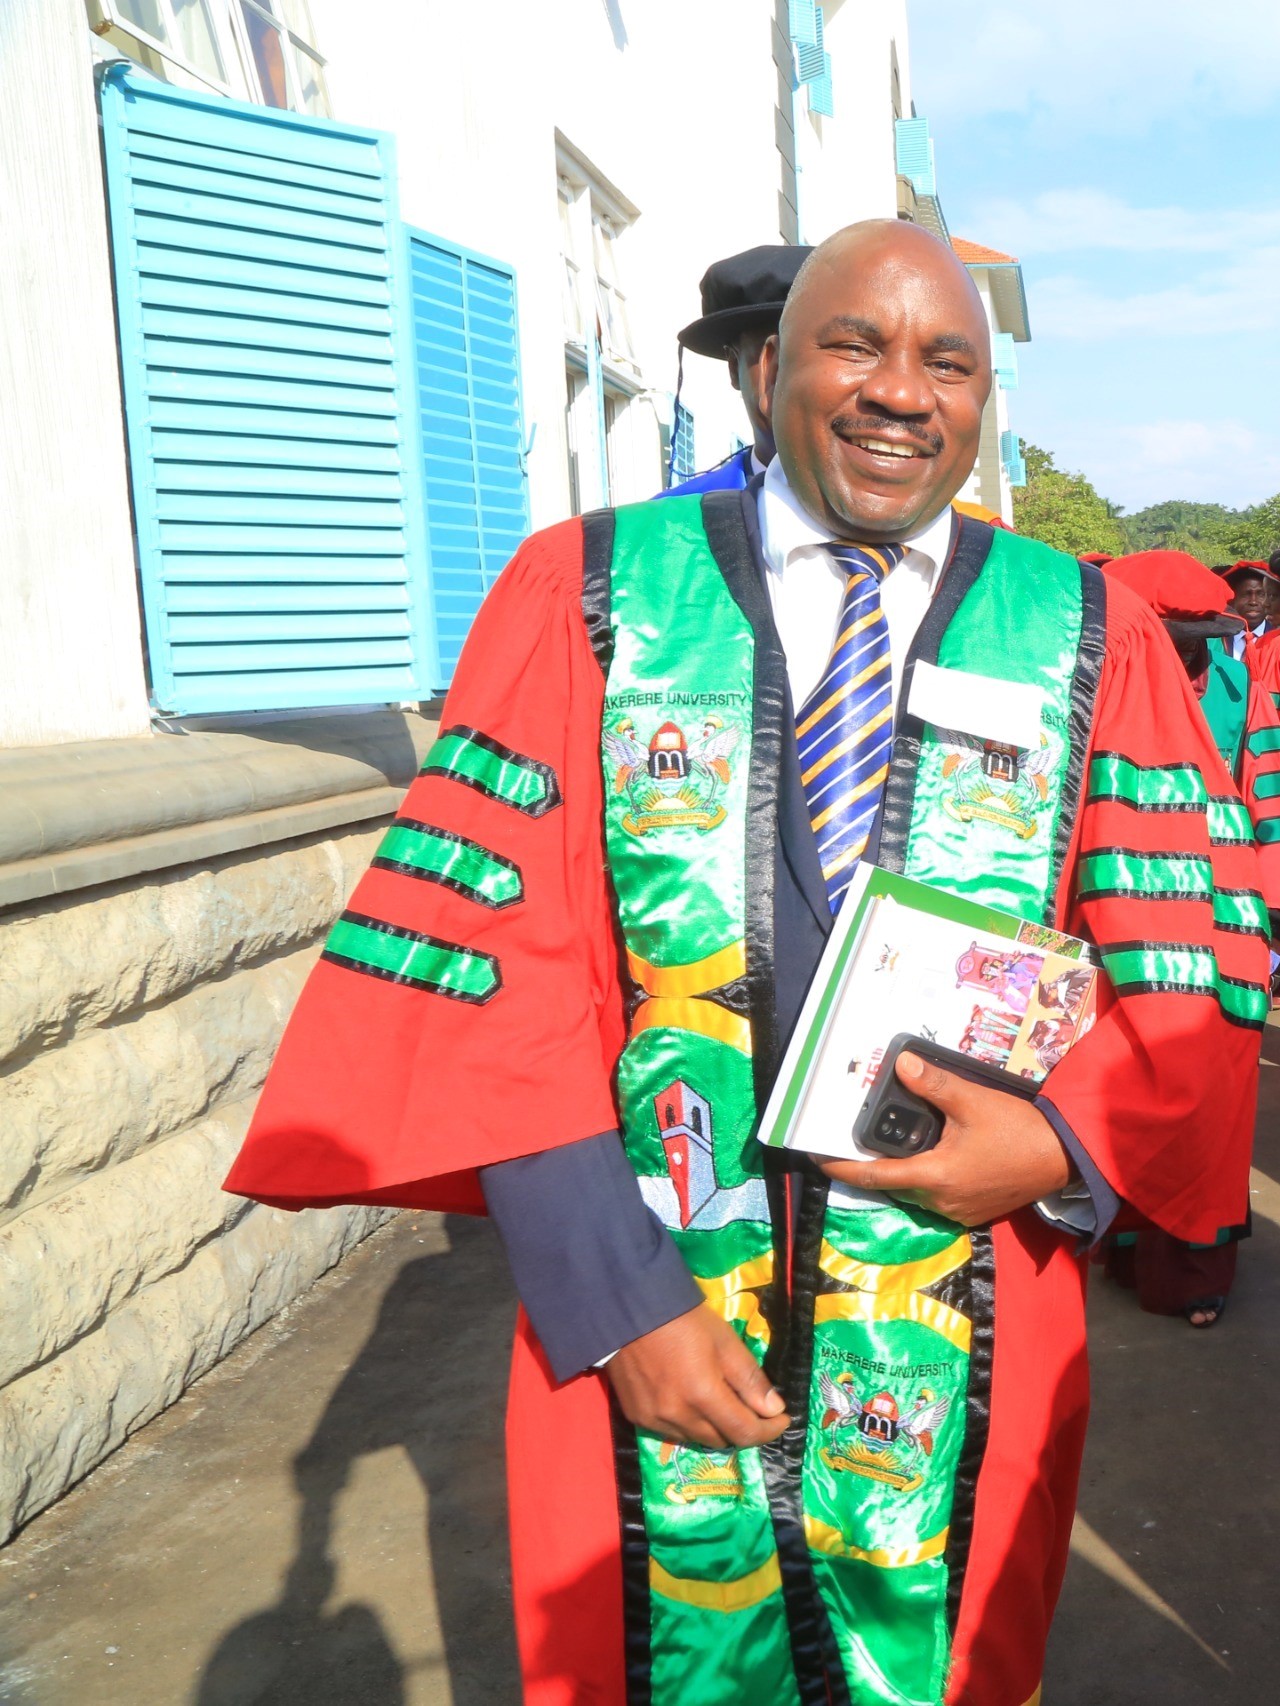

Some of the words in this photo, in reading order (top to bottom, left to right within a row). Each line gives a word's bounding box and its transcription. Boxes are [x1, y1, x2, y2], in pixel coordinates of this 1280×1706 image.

[604, 692, 663, 710] AKERERE
[667, 692, 747, 706] UNIVERSITY
[821, 1346, 886, 1374] MAKERERE
[889, 1363, 955, 1379] UNIVERSITY
